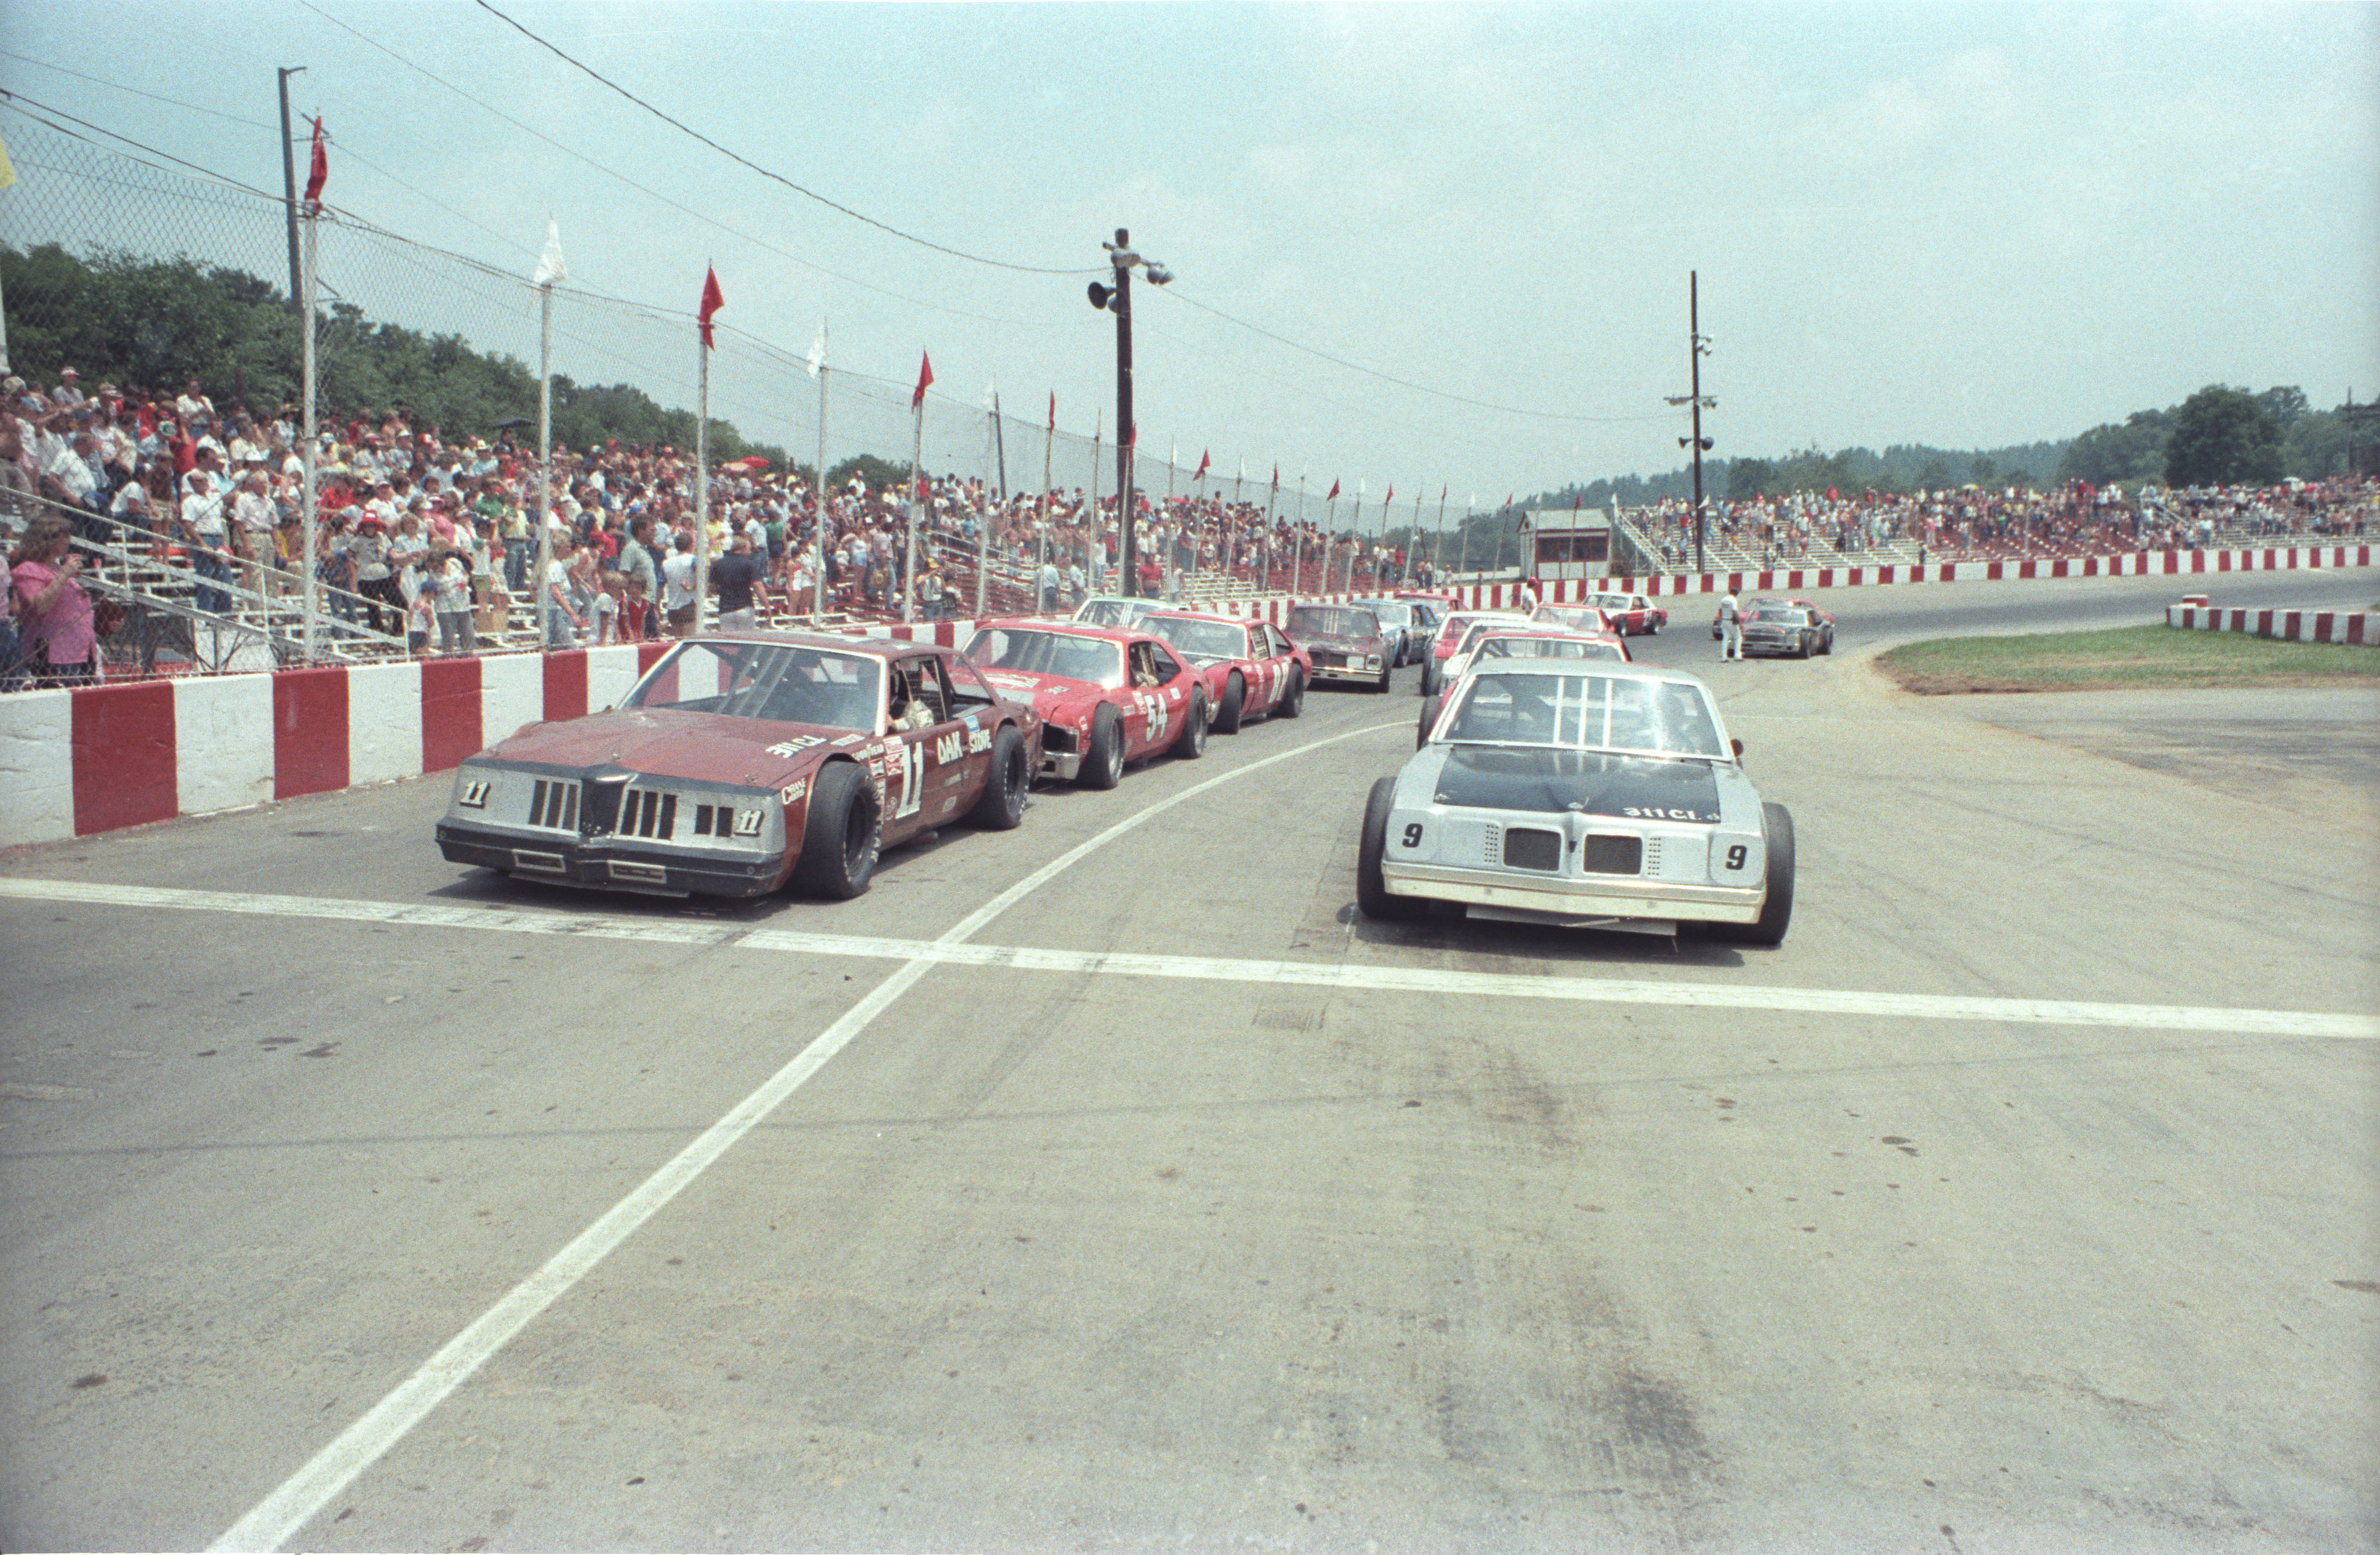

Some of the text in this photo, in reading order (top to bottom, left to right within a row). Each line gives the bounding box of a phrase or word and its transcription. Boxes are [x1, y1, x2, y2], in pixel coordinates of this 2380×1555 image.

[1144, 693, 1168, 743] 54
[895, 742, 924, 819] 11
[460, 781, 491, 809] 11
[733, 809, 765, 837] 11
[1402, 823, 1423, 848] 9
[1726, 845, 1748, 870] 9
